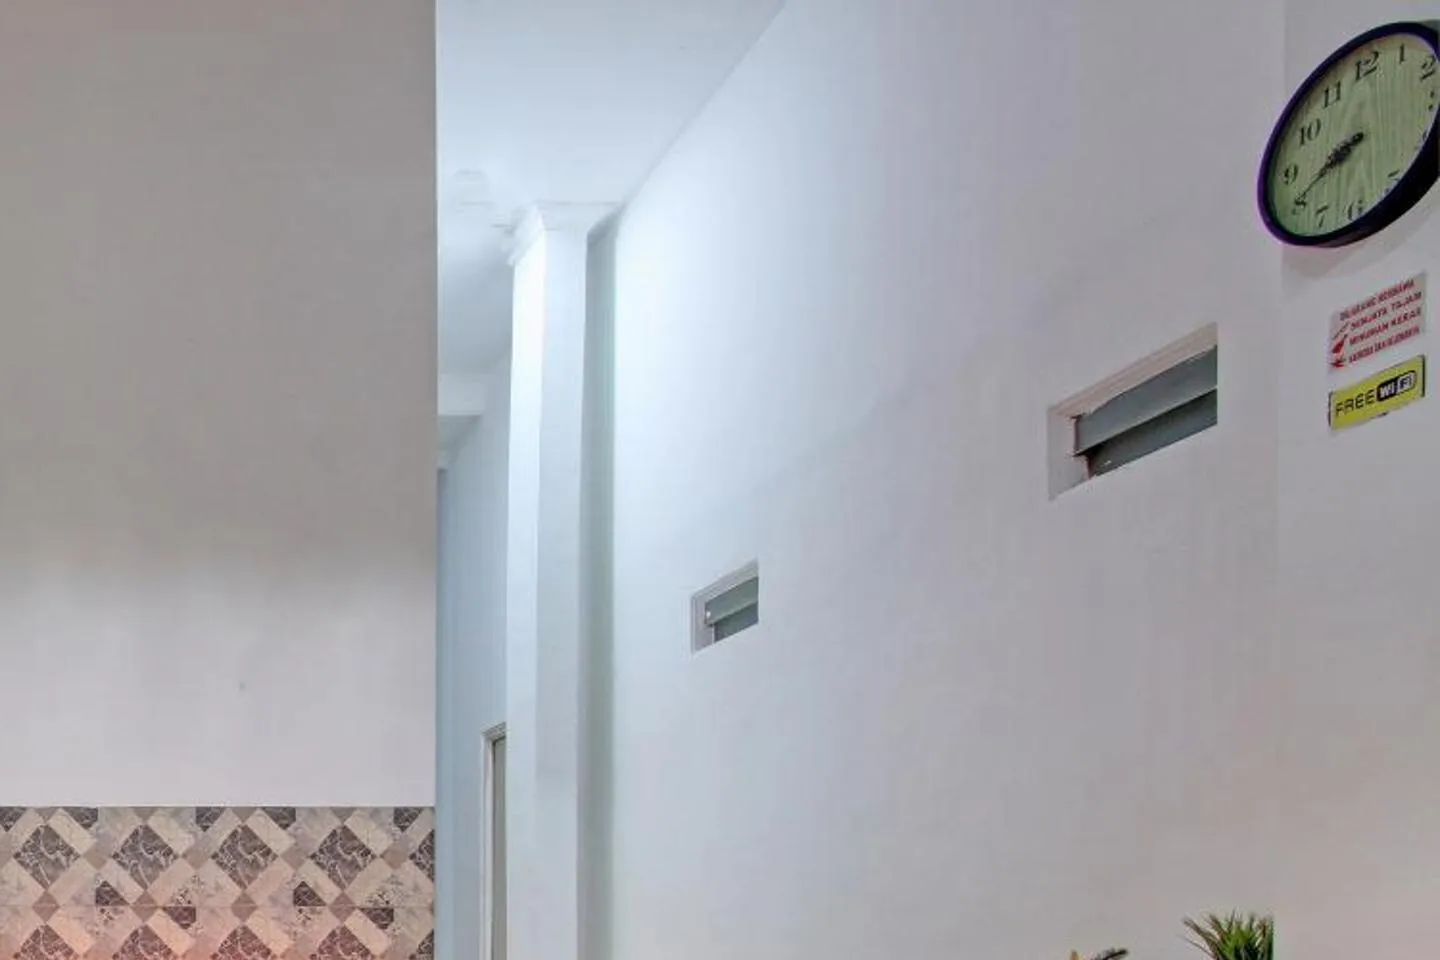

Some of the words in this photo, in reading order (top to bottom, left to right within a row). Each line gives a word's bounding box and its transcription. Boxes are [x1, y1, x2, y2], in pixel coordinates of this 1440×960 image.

[1354, 51, 1380, 82] 12
[1398, 43, 1406, 65] 1
[1324, 81, 1342, 109] 11
[1298, 118, 1321, 147] 10
[1283, 163, 1298, 185] 9
[1315, 204, 1329, 228] 7
[1335, 388, 1375, 417] FREE
